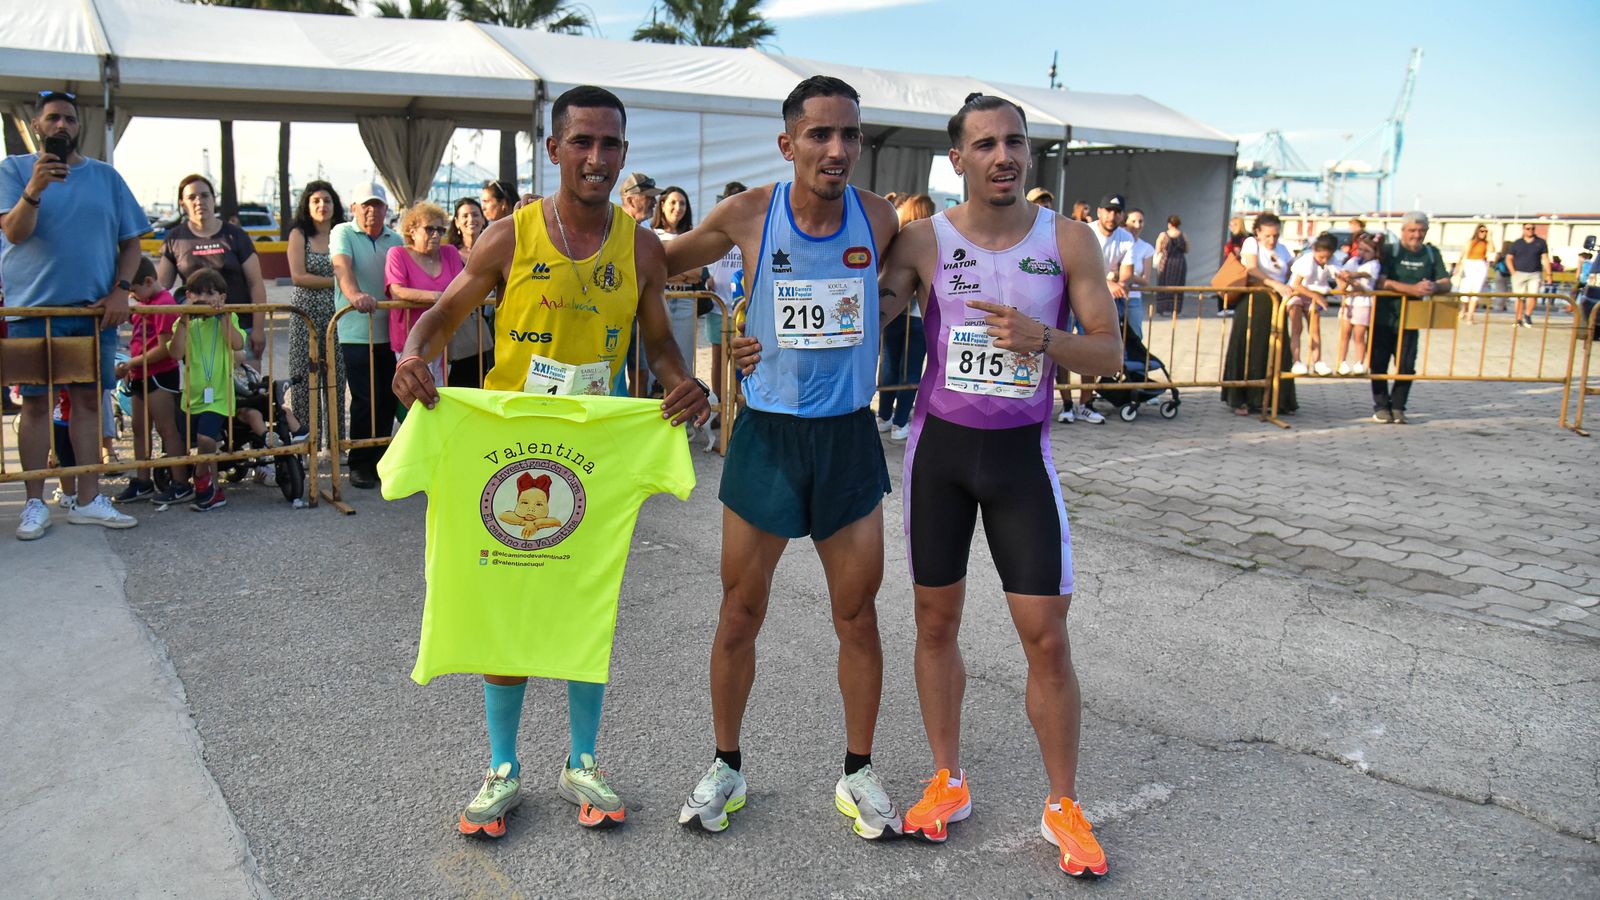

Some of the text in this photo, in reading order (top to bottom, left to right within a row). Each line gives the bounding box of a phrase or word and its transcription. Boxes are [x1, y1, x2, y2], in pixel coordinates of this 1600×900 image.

[943, 260, 977, 270] VIATOR
[778, 286, 794, 297] XXI
[782, 304, 825, 330] 219
[953, 331, 970, 342] XXI
[533, 361, 551, 375] XXI
[959, 350, 1004, 377] 815
[484, 442, 595, 475] Valentina
[567, 473, 581, 496] Cura
[483, 513, 579, 549] El camino de Valentina
